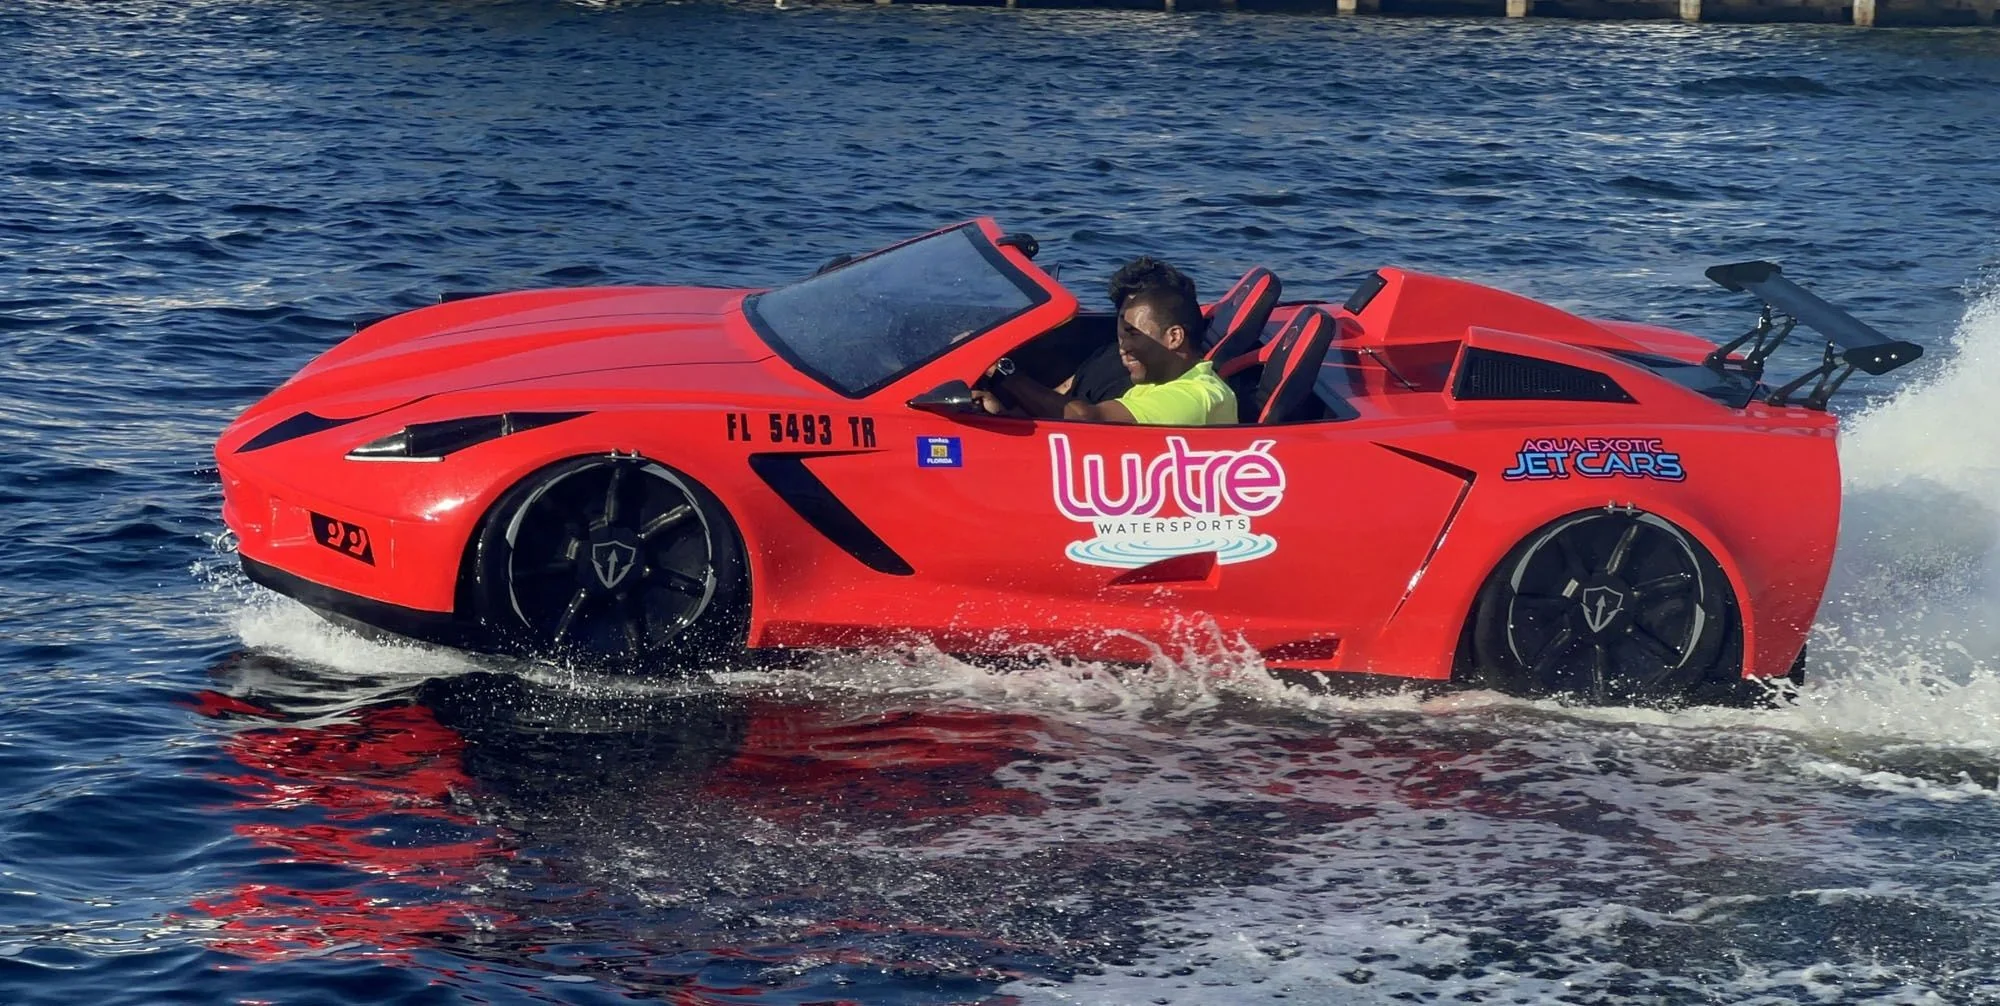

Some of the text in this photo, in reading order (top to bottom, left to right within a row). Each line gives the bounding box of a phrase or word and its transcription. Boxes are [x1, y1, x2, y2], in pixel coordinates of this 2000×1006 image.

[726, 413, 876, 448] FL 5493 TR
[1522, 439, 1662, 452] AQUA EXOTIC
[1505, 452, 1683, 479] JET CARS
[1098, 518, 1246, 534] WATERSPORTS
